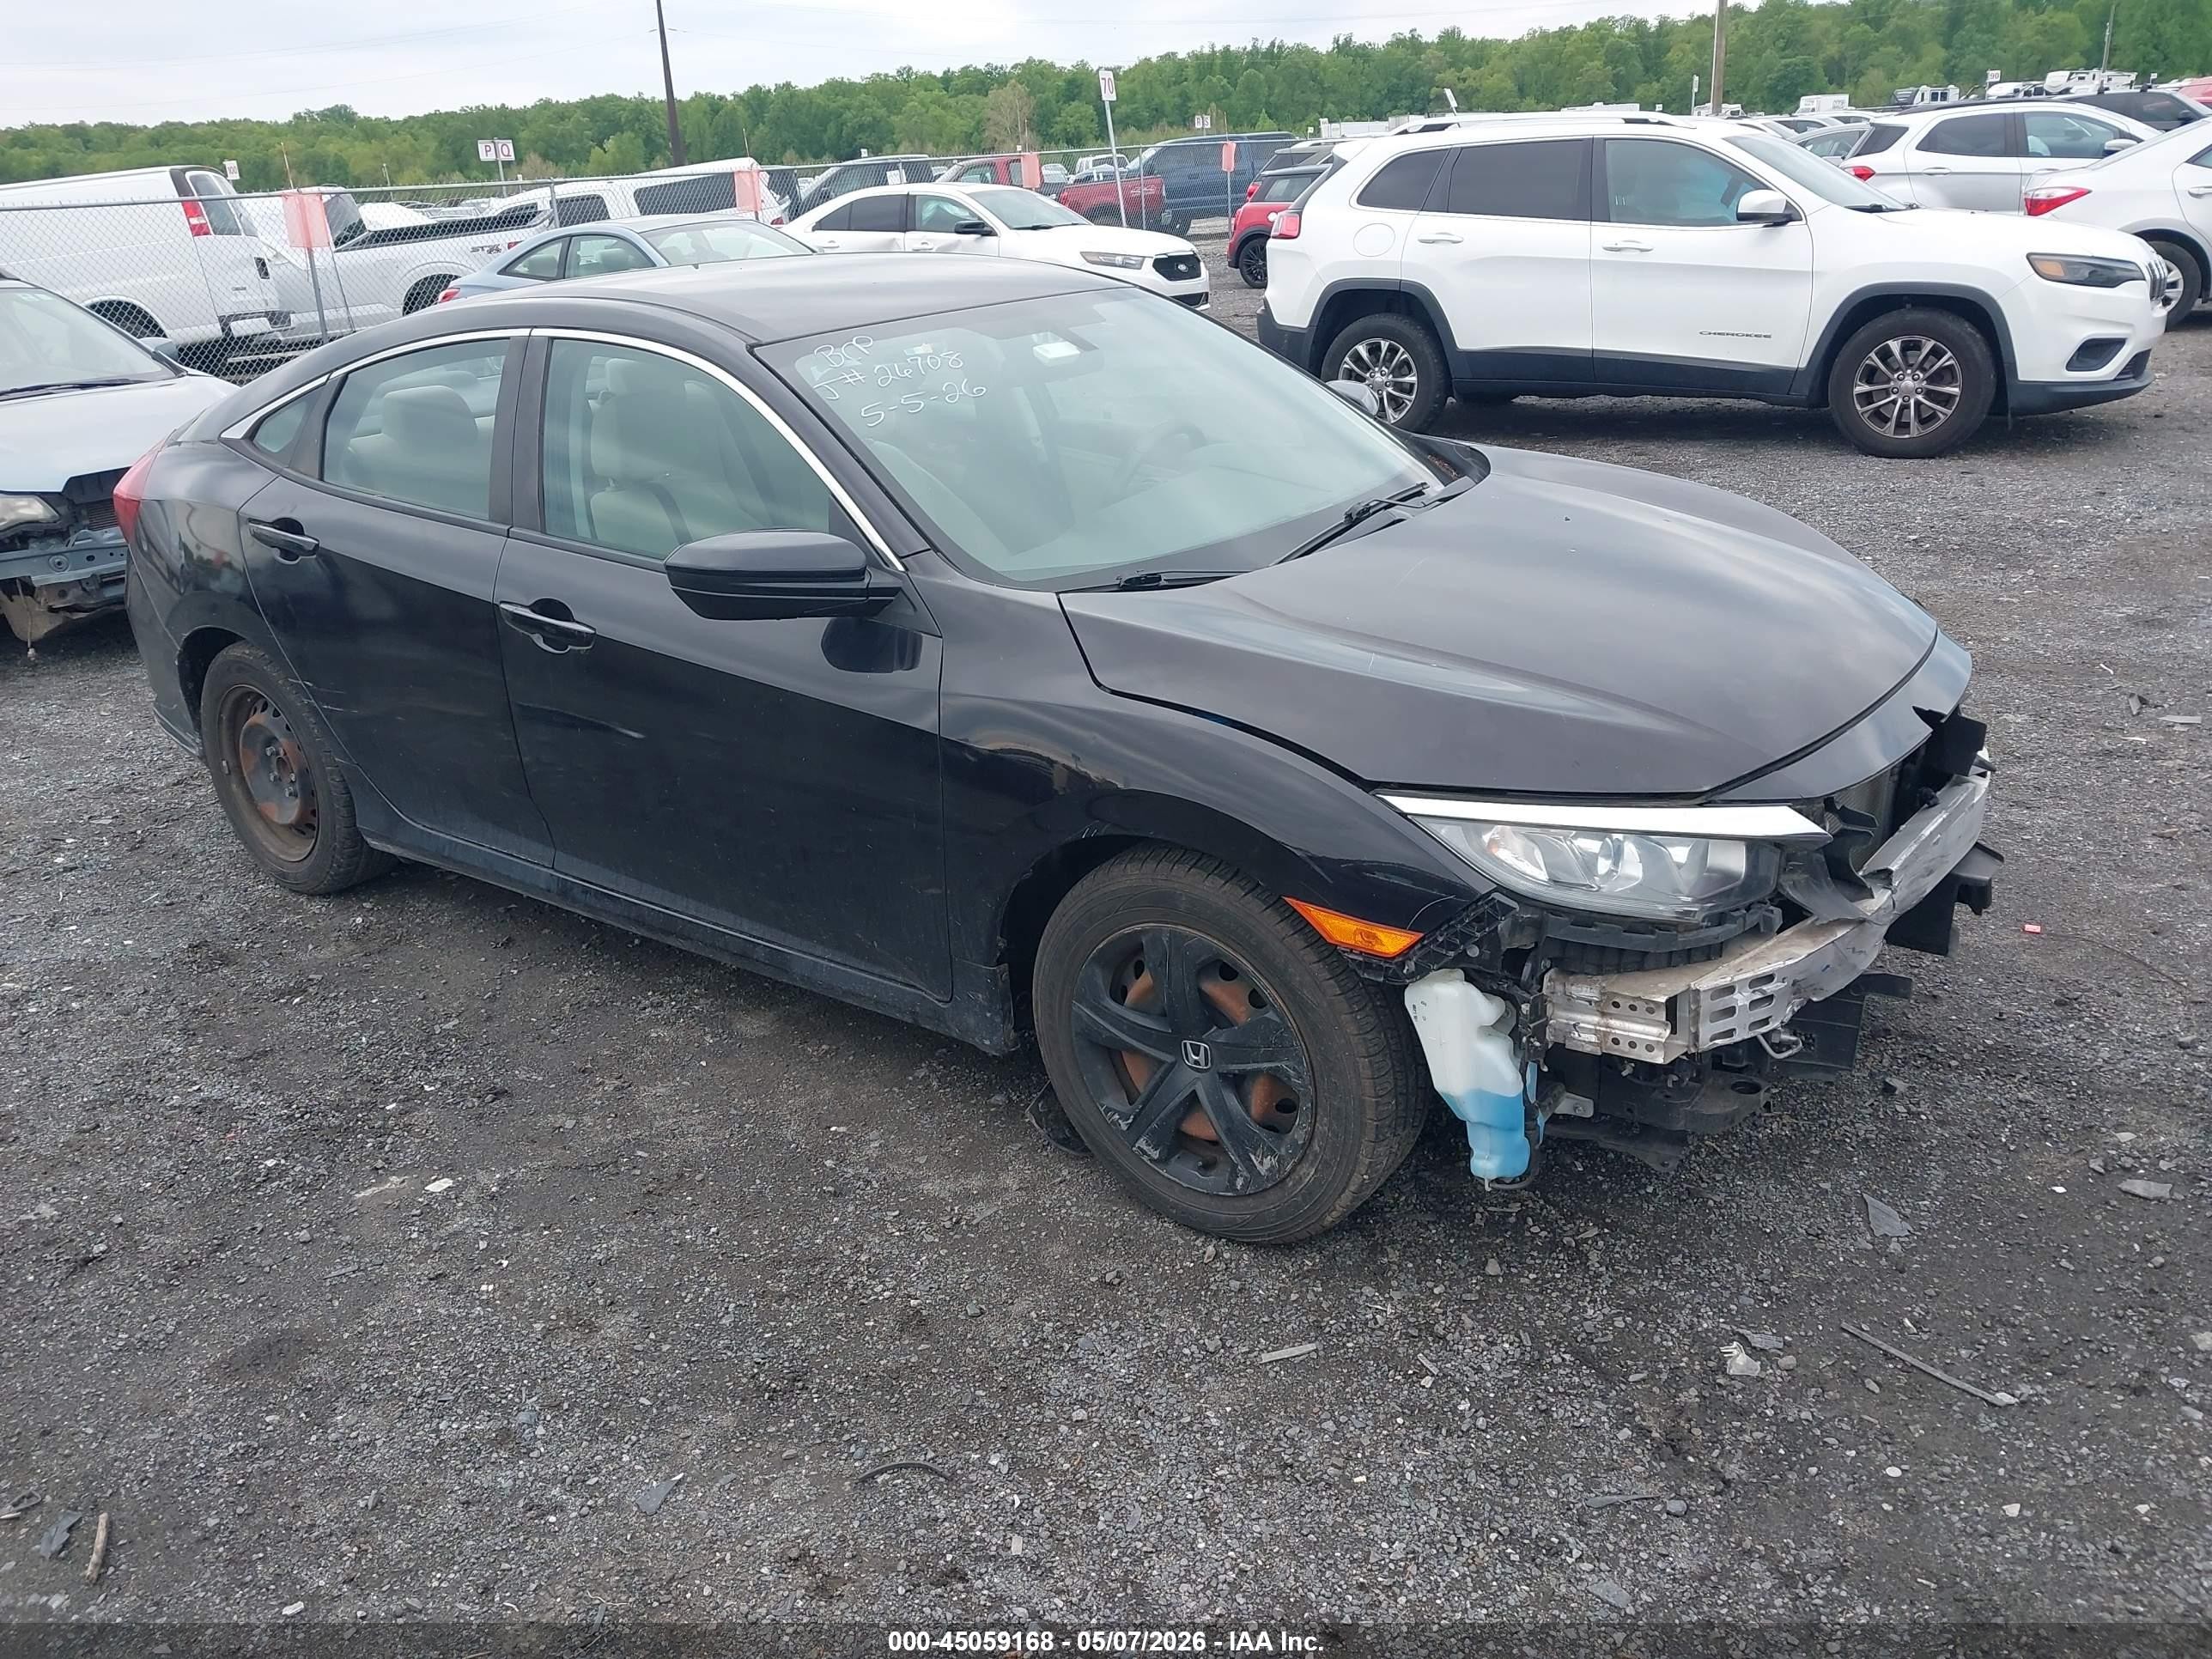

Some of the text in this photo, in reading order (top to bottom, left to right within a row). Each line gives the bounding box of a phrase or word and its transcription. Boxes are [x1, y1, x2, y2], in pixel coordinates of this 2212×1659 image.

[1101, 77, 1115, 95] 70
[484, 143, 513, 158] P Q
[1698, 331, 1773, 339] CHEROKEE
[874, 350, 964, 387] 26708
[860, 378, 988, 427] 5-5-26
